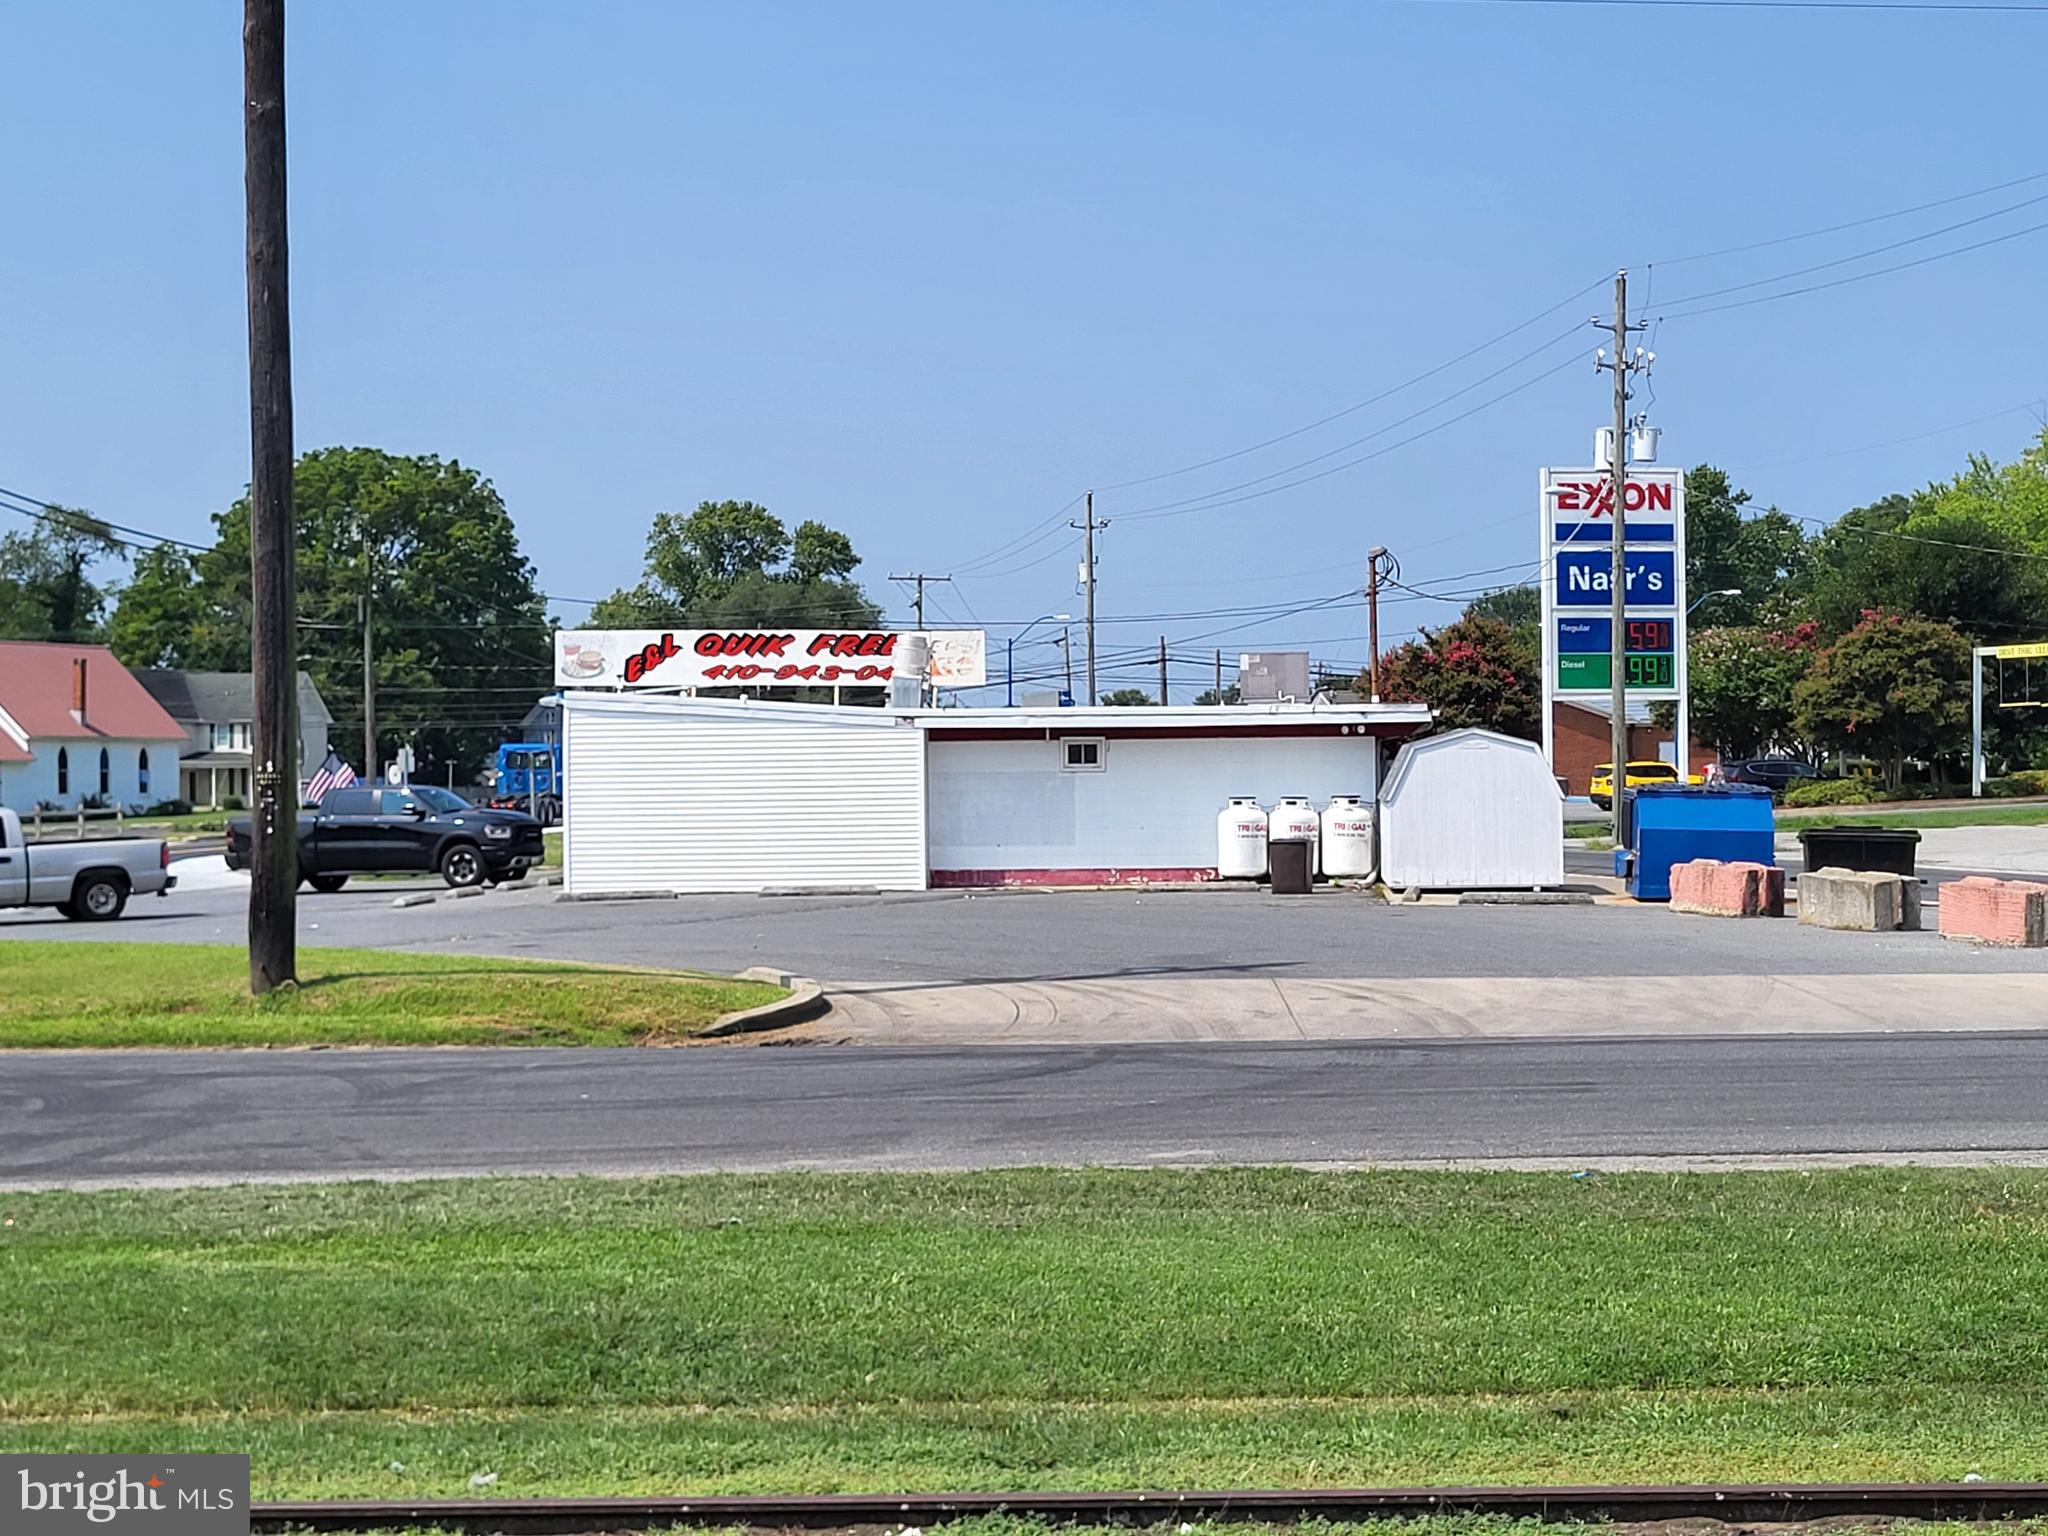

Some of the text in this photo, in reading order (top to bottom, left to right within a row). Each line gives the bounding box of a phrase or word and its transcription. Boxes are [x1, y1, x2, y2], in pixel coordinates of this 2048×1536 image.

[1557, 479, 1671, 518] EXXON
[1569, 565, 1663, 591] Nar's
[1560, 624, 1590, 634] Regular
[624, 633, 898, 683] E&L QUIK FREE
[1561, 660, 1586, 669] Diesel
[701, 664, 895, 681] 410-943-04
